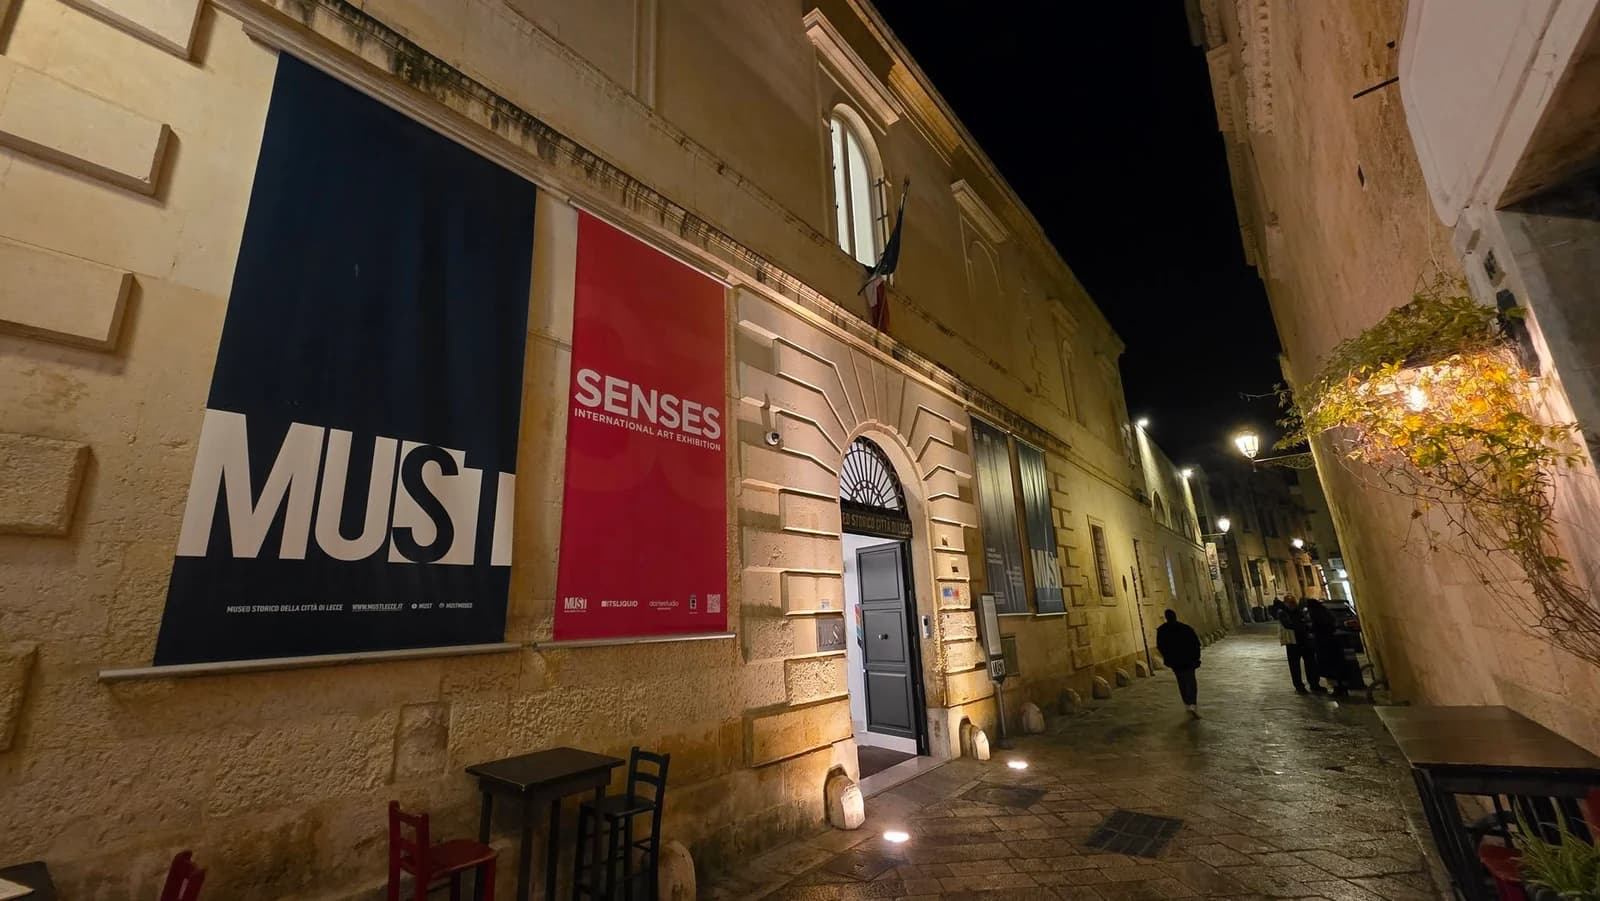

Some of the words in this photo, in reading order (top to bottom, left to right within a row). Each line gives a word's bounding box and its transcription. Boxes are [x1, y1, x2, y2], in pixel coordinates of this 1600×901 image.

[574, 368, 721, 440] SENSES
[574, 407, 654, 436] INTERNATIONAL
[656, 428, 674, 440] ART
[676, 433, 721, 452] EXHIBITION
[226, 604, 251, 614] MUSEO
[251, 604, 280, 613] STORICO
[280, 604, 300, 612] DELLA
[300, 603, 317, 612] CITTÀ
[318, 603, 325, 611] DI
[325, 603, 344, 611] LECCE
